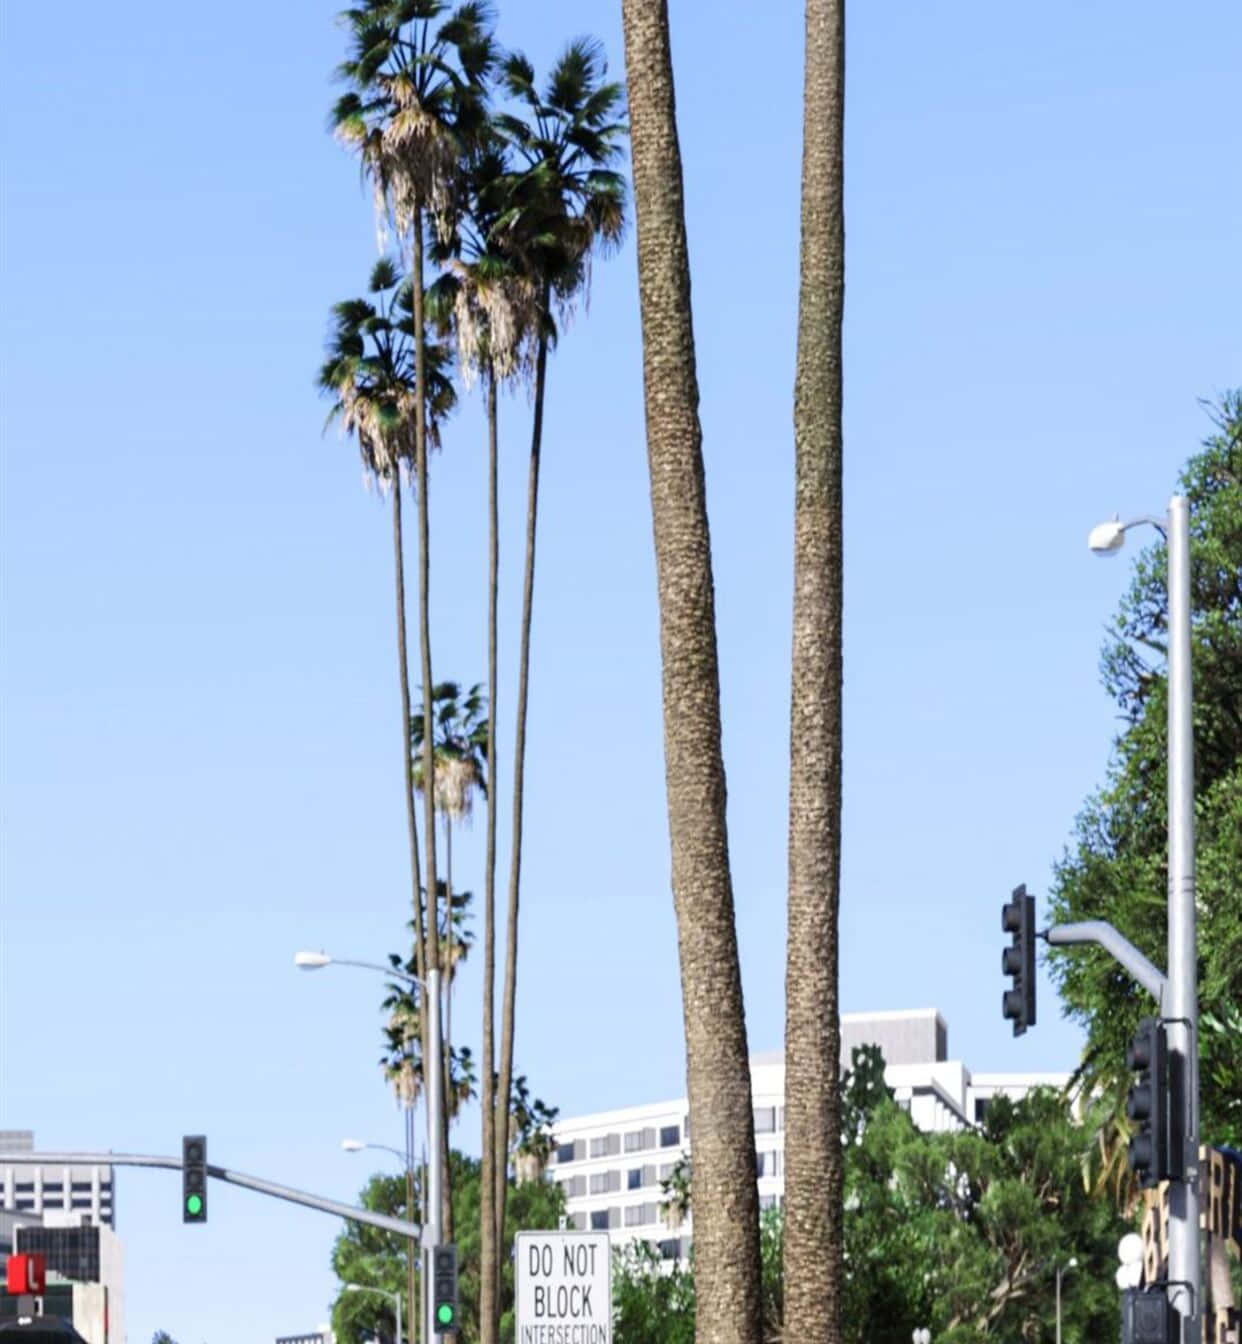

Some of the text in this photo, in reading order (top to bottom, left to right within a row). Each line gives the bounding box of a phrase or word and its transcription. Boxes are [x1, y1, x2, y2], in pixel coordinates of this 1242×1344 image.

[529, 1244, 597, 1277] DO NOT
[534, 1285, 592, 1318] BLOCK
